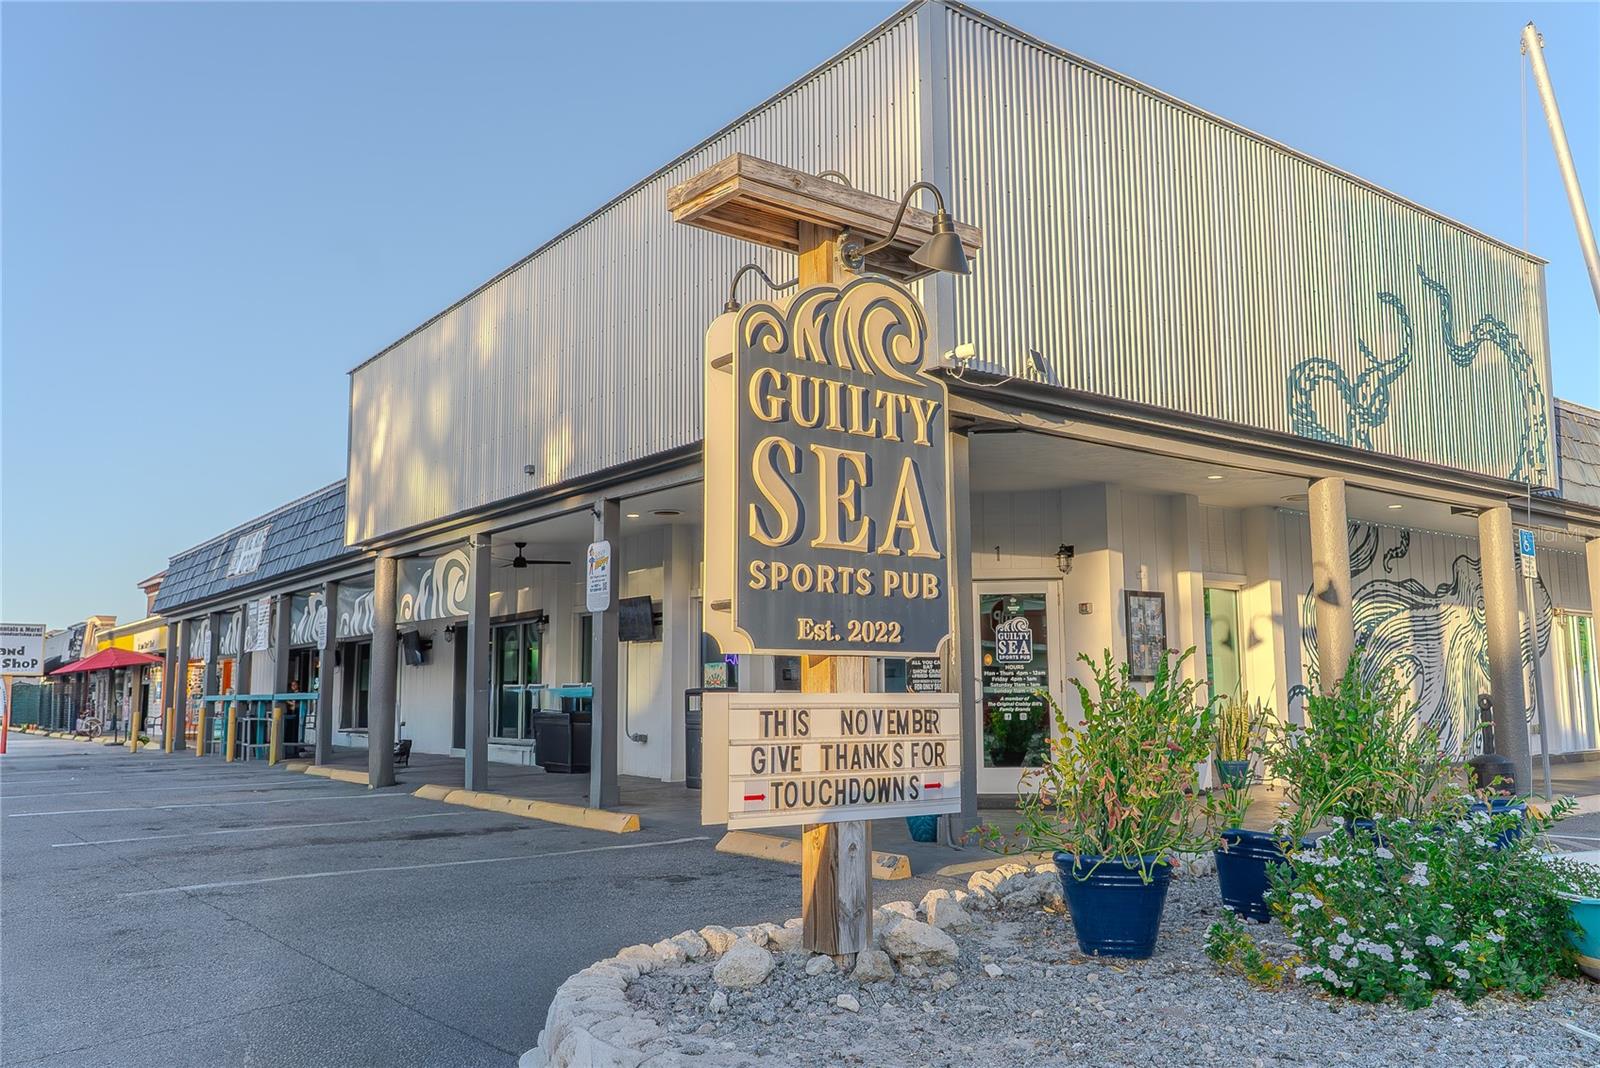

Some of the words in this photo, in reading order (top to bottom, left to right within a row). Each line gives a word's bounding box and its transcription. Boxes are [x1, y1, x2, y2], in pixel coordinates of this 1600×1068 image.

[749, 367, 942, 447] GUILTY
[749, 436, 942, 559] SEA
[749, 560, 873, 596] SPORTS
[883, 570, 941, 600] PUB
[797, 618, 841, 641] Est.
[847, 620, 902, 643] 2022
[998, 632, 1030, 640] GUILTY
[998, 640, 1030, 655] SEA
[759, 709, 809, 738] THIS
[840, 709, 940, 736] NOVEMBER
[751, 745, 801, 775] GIVE
[820, 742, 904, 771] THANKS
[911, 742, 946, 768] FOR
[770, 775, 919, 809] TOUCHDOWNS
